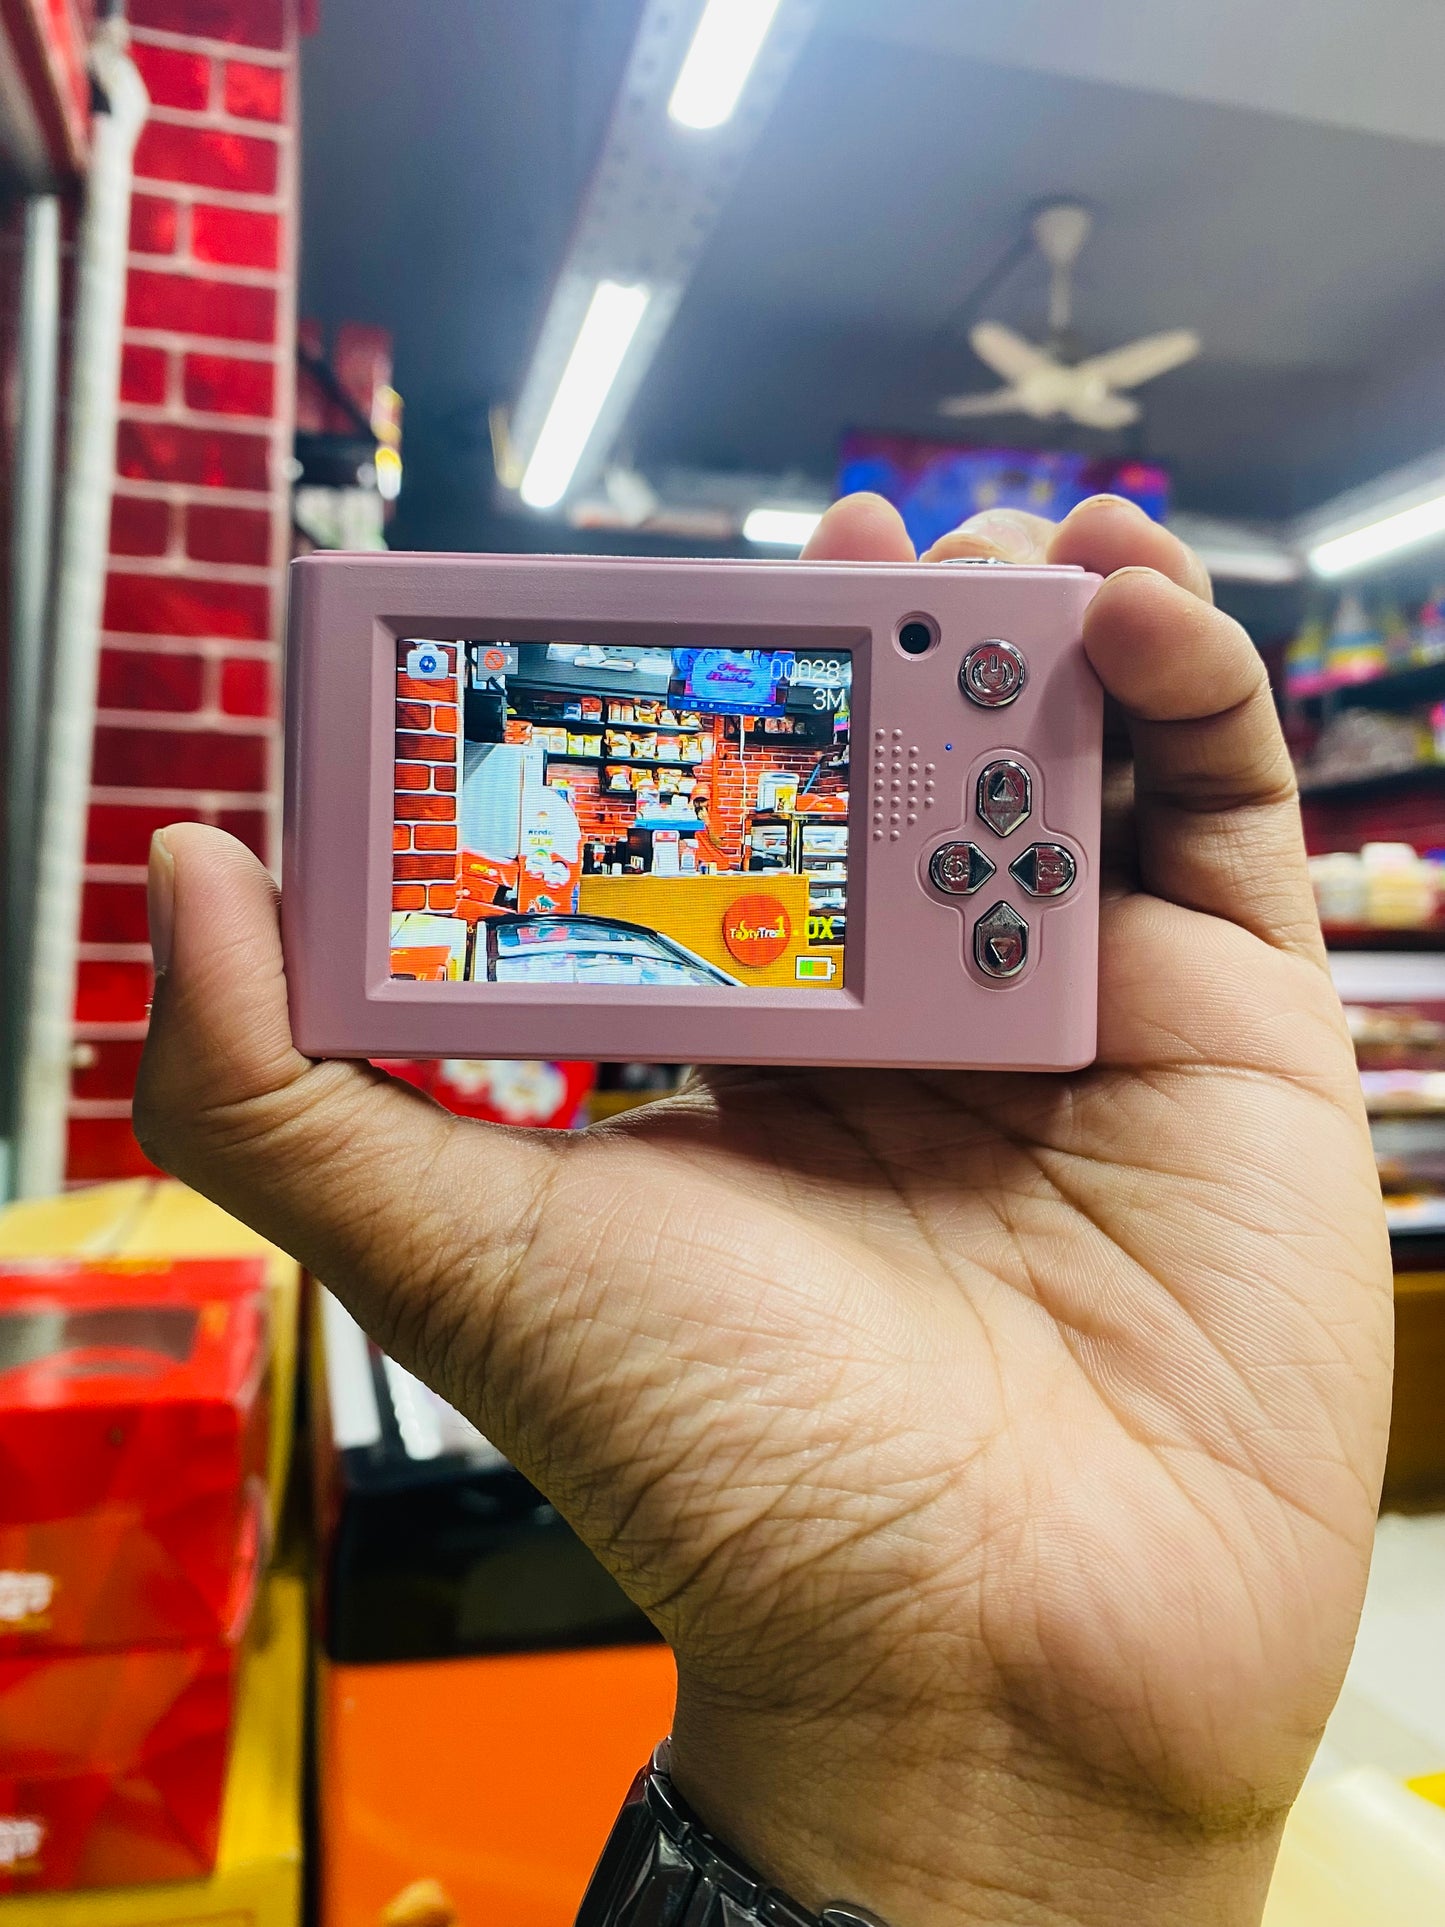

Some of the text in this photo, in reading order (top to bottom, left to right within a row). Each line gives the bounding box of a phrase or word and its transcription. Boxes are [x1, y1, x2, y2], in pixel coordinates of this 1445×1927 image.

[770, 658, 840, 681] 00028
[812, 688, 846, 711] 3M
[729, 919, 786, 942] TastyTrea
